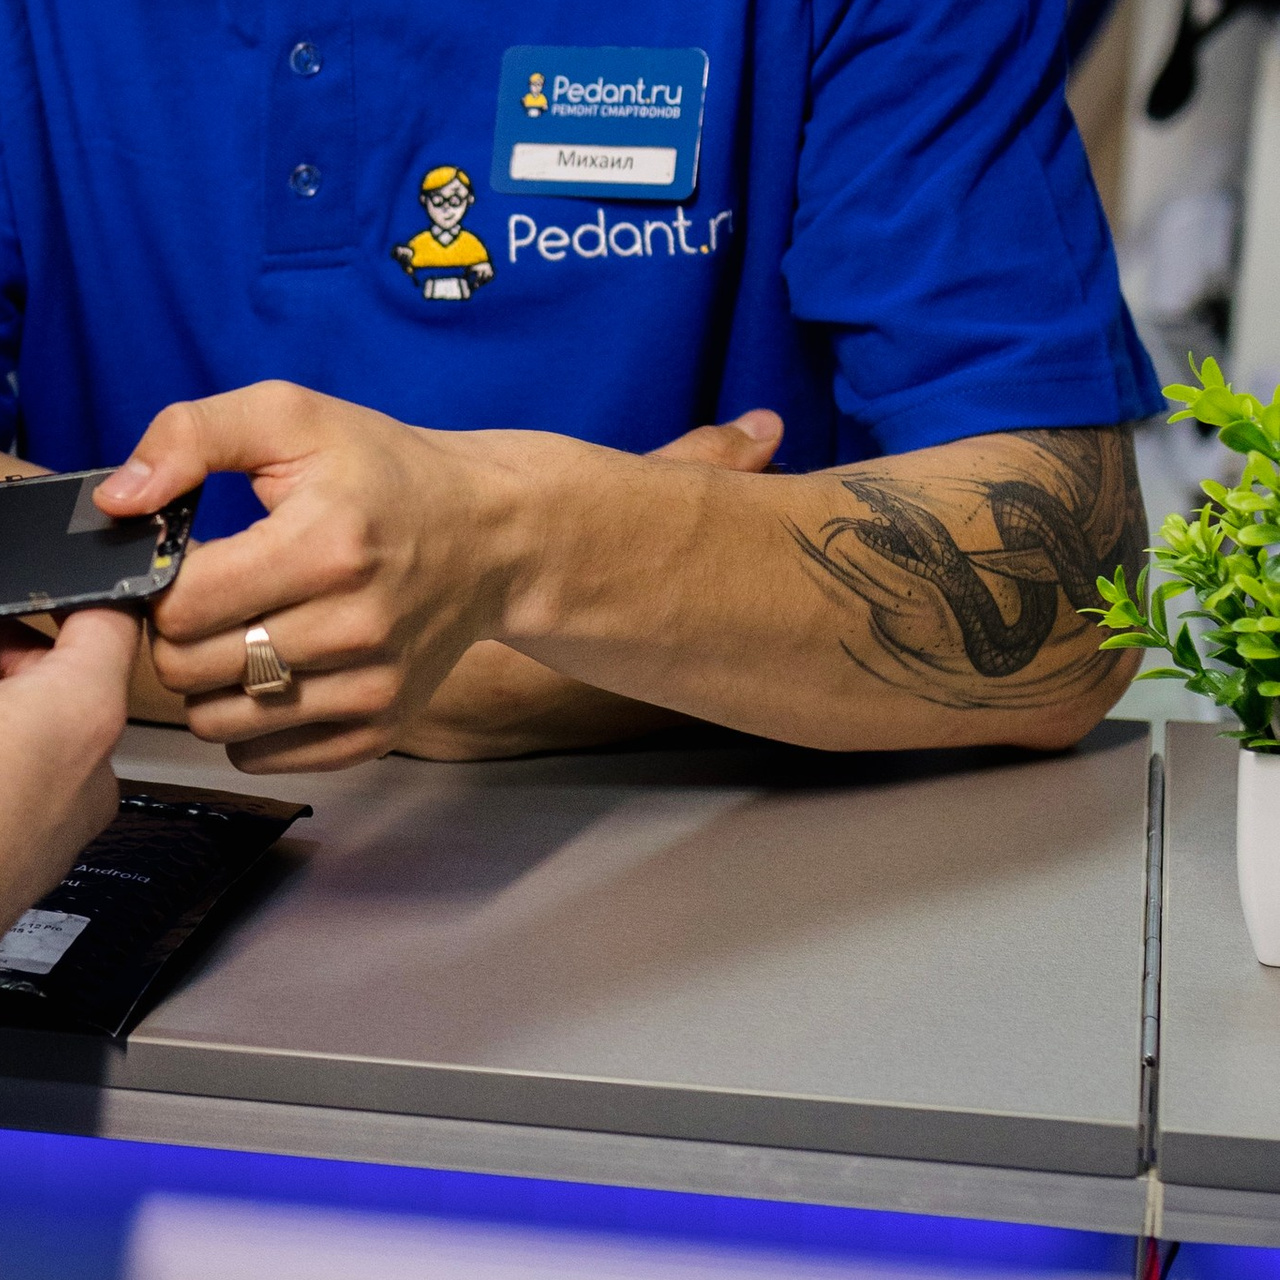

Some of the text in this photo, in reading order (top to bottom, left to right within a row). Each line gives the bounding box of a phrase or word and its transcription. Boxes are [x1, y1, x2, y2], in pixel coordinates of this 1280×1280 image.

[552, 75, 683, 105] Pedant.ru
[551, 104, 681, 119] РЕМОНТ СМАРТФОНОВ
[558, 150, 634, 170] Михаил
[508, 206, 732, 263] Pedant.r
[60, 879, 80, 887] ru
[75, 864, 151, 884] Android
